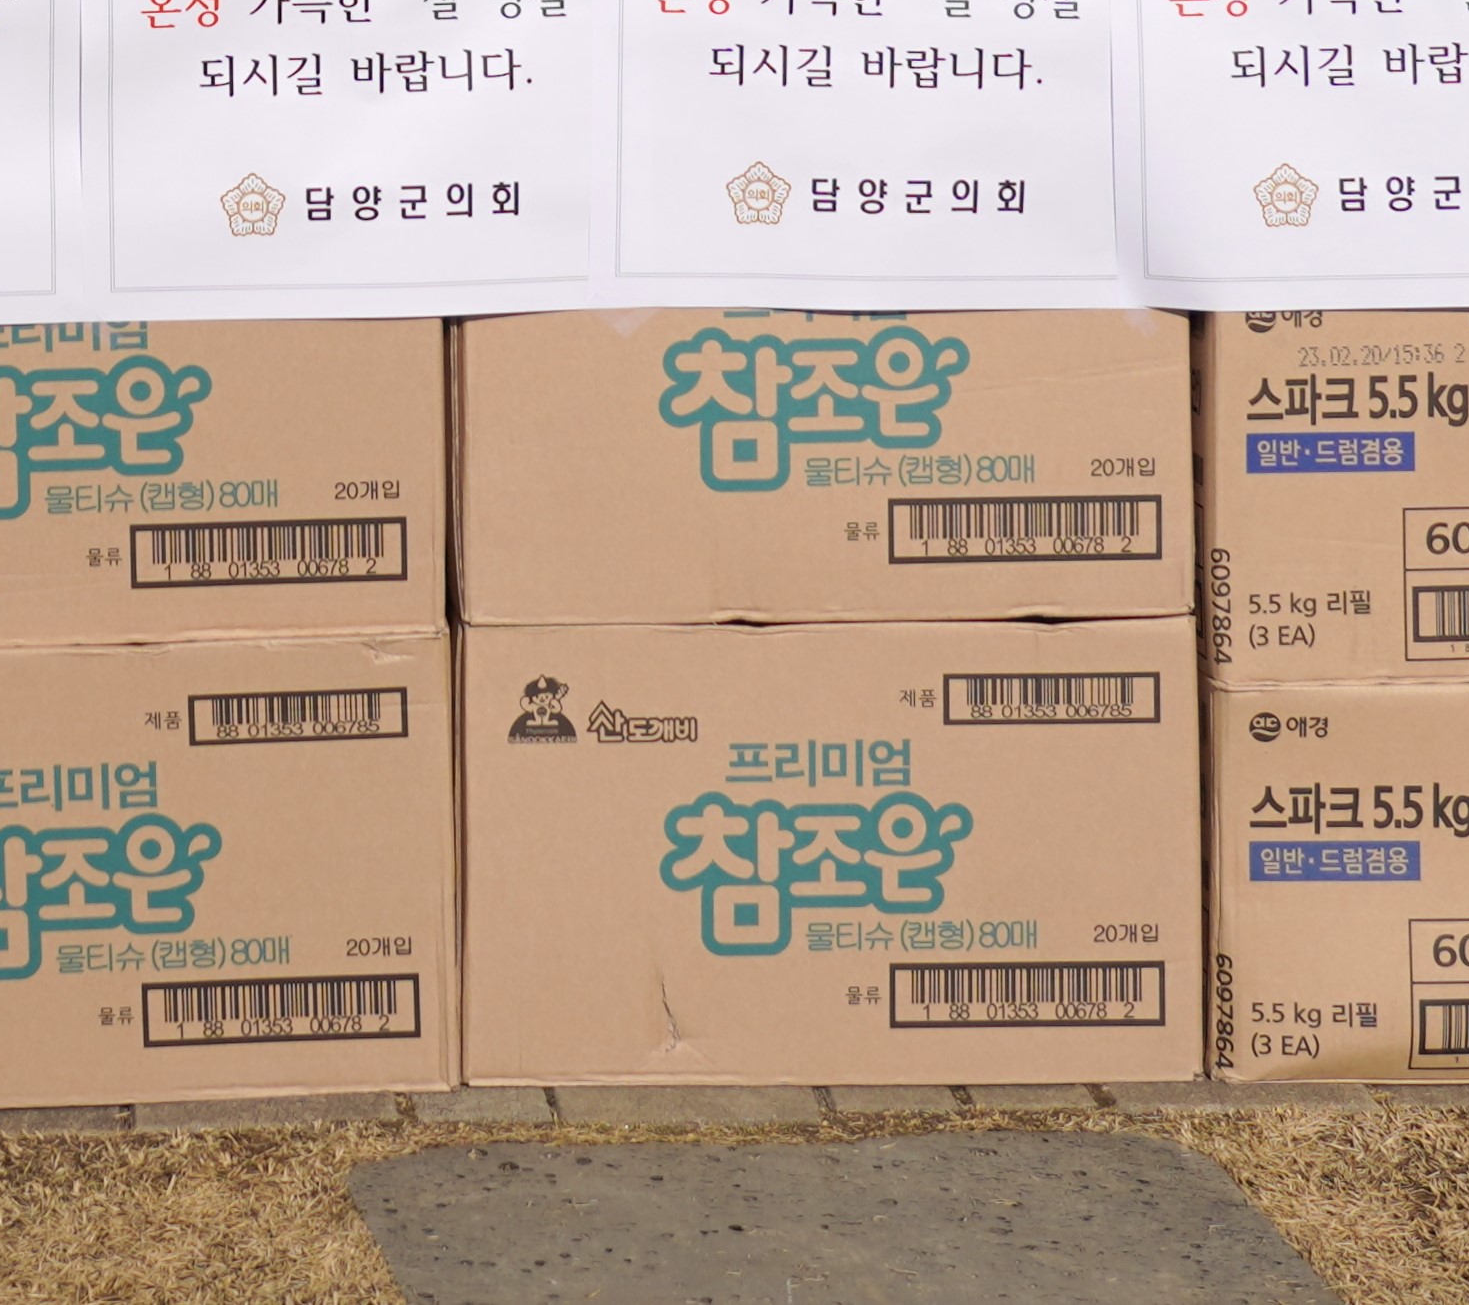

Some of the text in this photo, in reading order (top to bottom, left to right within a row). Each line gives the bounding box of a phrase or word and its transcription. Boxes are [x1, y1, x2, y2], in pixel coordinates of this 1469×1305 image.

[200, 48, 533, 98] 되시길 바랍니다.
[709, 43, 1043, 91] 되시길 바랍니다.
[1231, 43, 1355, 88] 되시길
[305, 181, 520, 222] 담양군의회
[746, 186, 771, 203] 의회
[811, 178, 1025, 215] 담양군의회
[1275, 189, 1300, 205] 의회
[1297, 342, 1445, 368] 23.02.20/15:36
[658, 326, 970, 493] 참조은
[1246, 373, 1360, 426] 스파크
[1369, 374, 1419, 420] 5.5
[1427, 371, 1469, 428] kg
[804, 453, 1035, 487] 물티슈 (캡형) 80매
[1090, 457, 1156, 477] 20개입
[44, 478, 279, 515] 물티슈 (캡형) 80매
[333, 479, 401, 501] 20개입
[86, 547, 123, 568] 물류
[190, 559, 350, 580] 88 01353 00678
[1209, 546, 1233, 667] 6097864
[1248, 590, 1371, 618] 5.5 kg 리필
[1248, 623, 1316, 650] (3 EA)
[899, 688, 937, 709] 제품
[144, 710, 182, 731] 제품
[586, 699, 699, 744] 산도깨비
[1285, 716, 1329, 739] 애경
[725, 738, 911, 788] 프리미엄
[1249, 782, 1364, 835] 스파크
[1373, 785, 1424, 829] 5.5
[660, 791, 972, 956] 참조은
[346, 936, 413, 957] 20개입
[805, 914, 1038, 952] 물티슈 (캡형) 80매
[1093, 923, 1159, 943] 20개입
[56, 935, 290, 974] 물티슈 (캡형) 80매
[845, 985, 882, 1006] 물류
[1214, 953, 1234, 1071] 6097864
[98, 1006, 134, 1026] 물류
